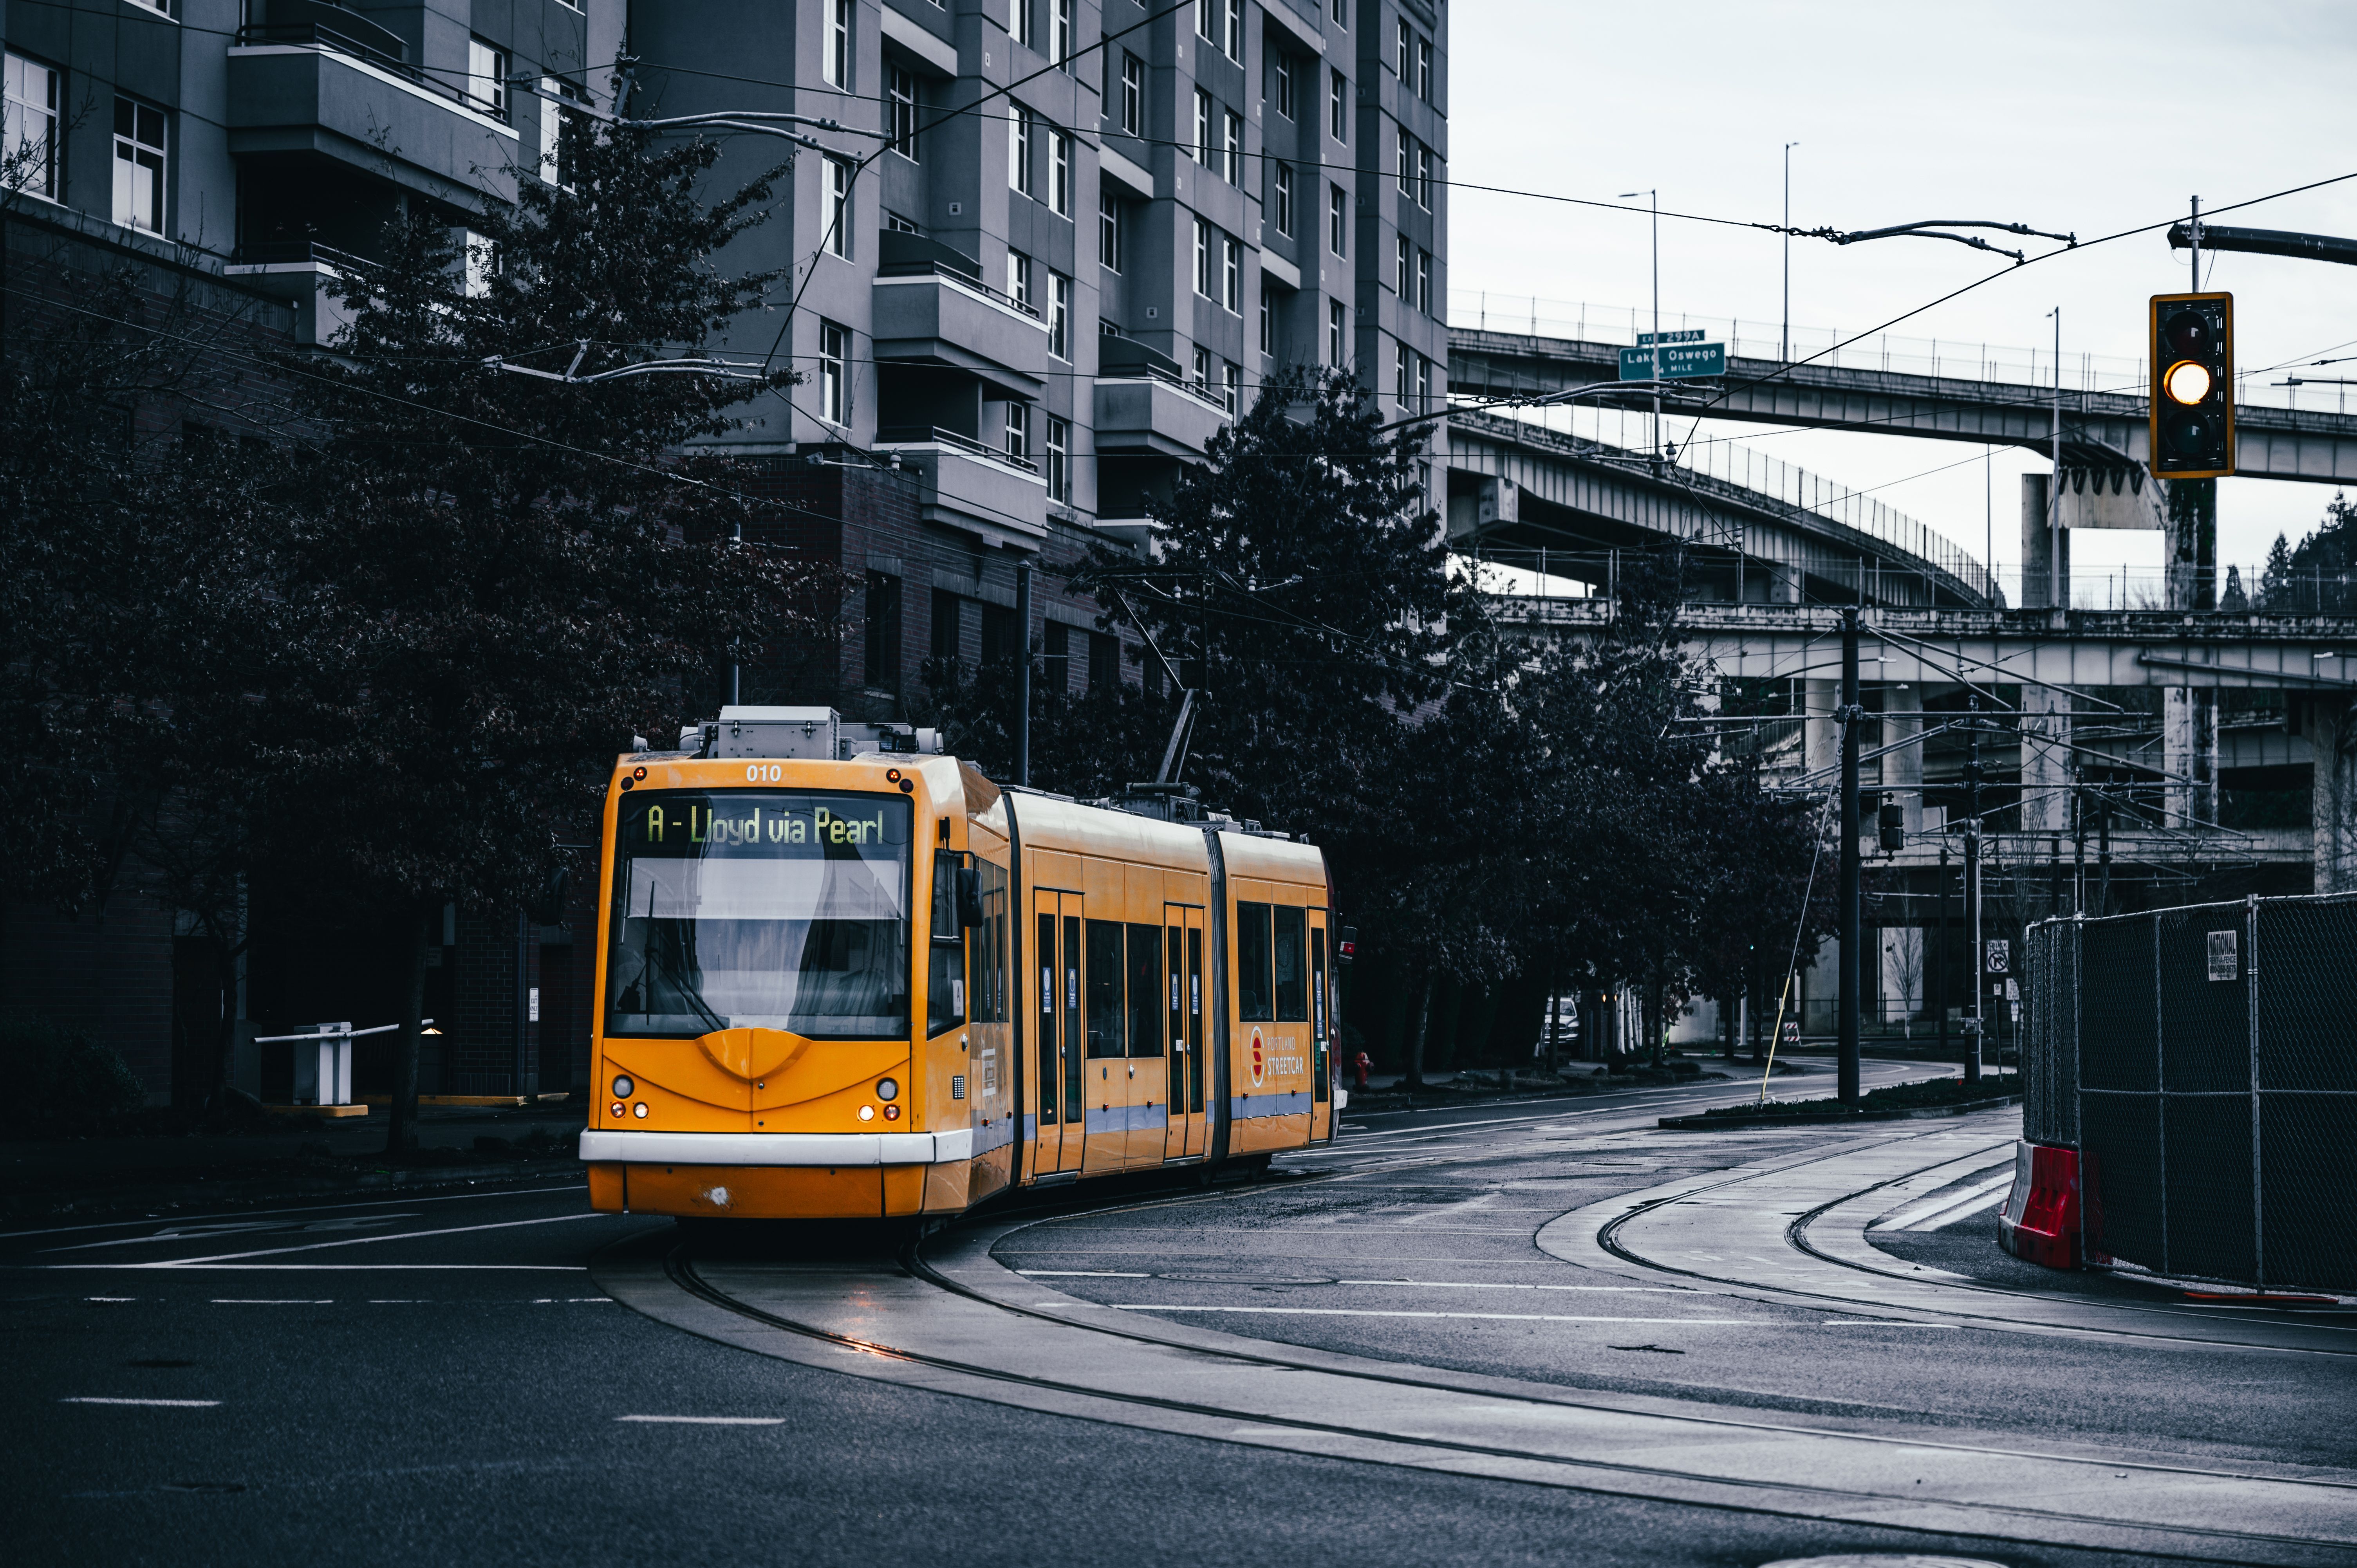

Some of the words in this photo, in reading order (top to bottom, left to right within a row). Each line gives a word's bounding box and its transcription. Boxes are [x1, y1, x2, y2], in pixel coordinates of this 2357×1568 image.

[1667, 331, 1700, 343] 299A
[1669, 350, 1716, 361] Oswego
[1671, 363, 1692, 372] MILE
[746, 765, 782, 782] 010
[648, 805, 663, 842] A
[691, 805, 760, 846] Lloyd
[768, 811, 805, 844] via
[814, 807, 883, 844] Pearl
[2209, 933, 2236, 956] NATIONAL
[2209, 956, 2236, 964] RENT-A-FENCE
[1267, 1037, 1296, 1051] PORTLAND
[1268, 1056, 1304, 1075] STREETCAR
